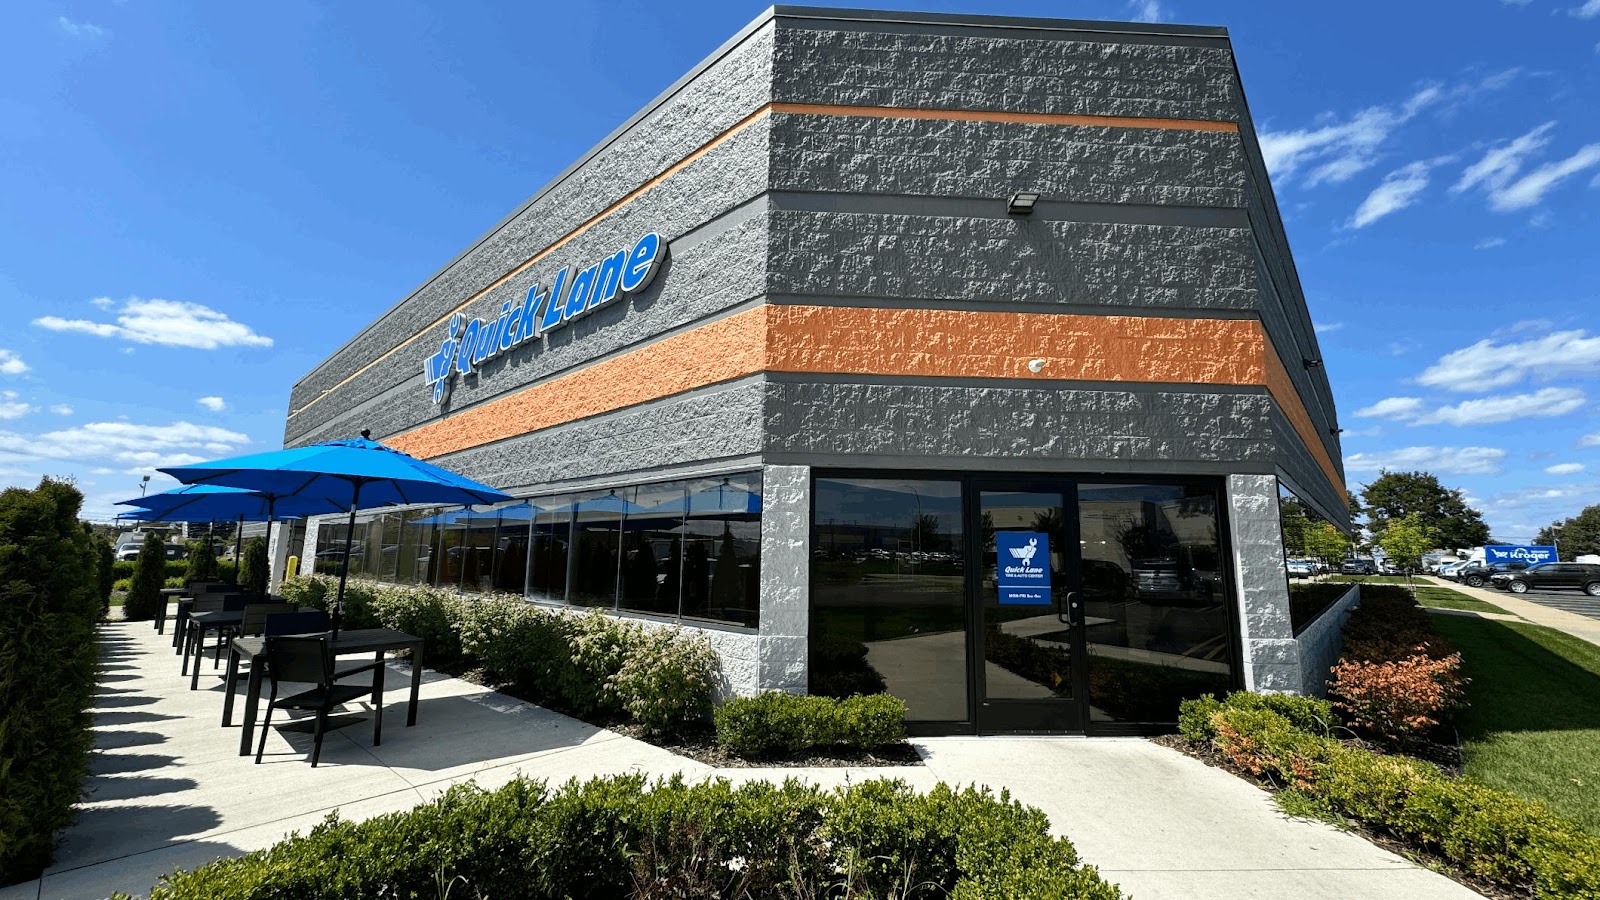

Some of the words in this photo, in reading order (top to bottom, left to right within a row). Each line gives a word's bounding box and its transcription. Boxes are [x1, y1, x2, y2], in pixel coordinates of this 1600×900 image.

[456, 283, 547, 376] Quick
[540, 232, 660, 332] Lane
[1509, 548, 1550, 564] Kroger
